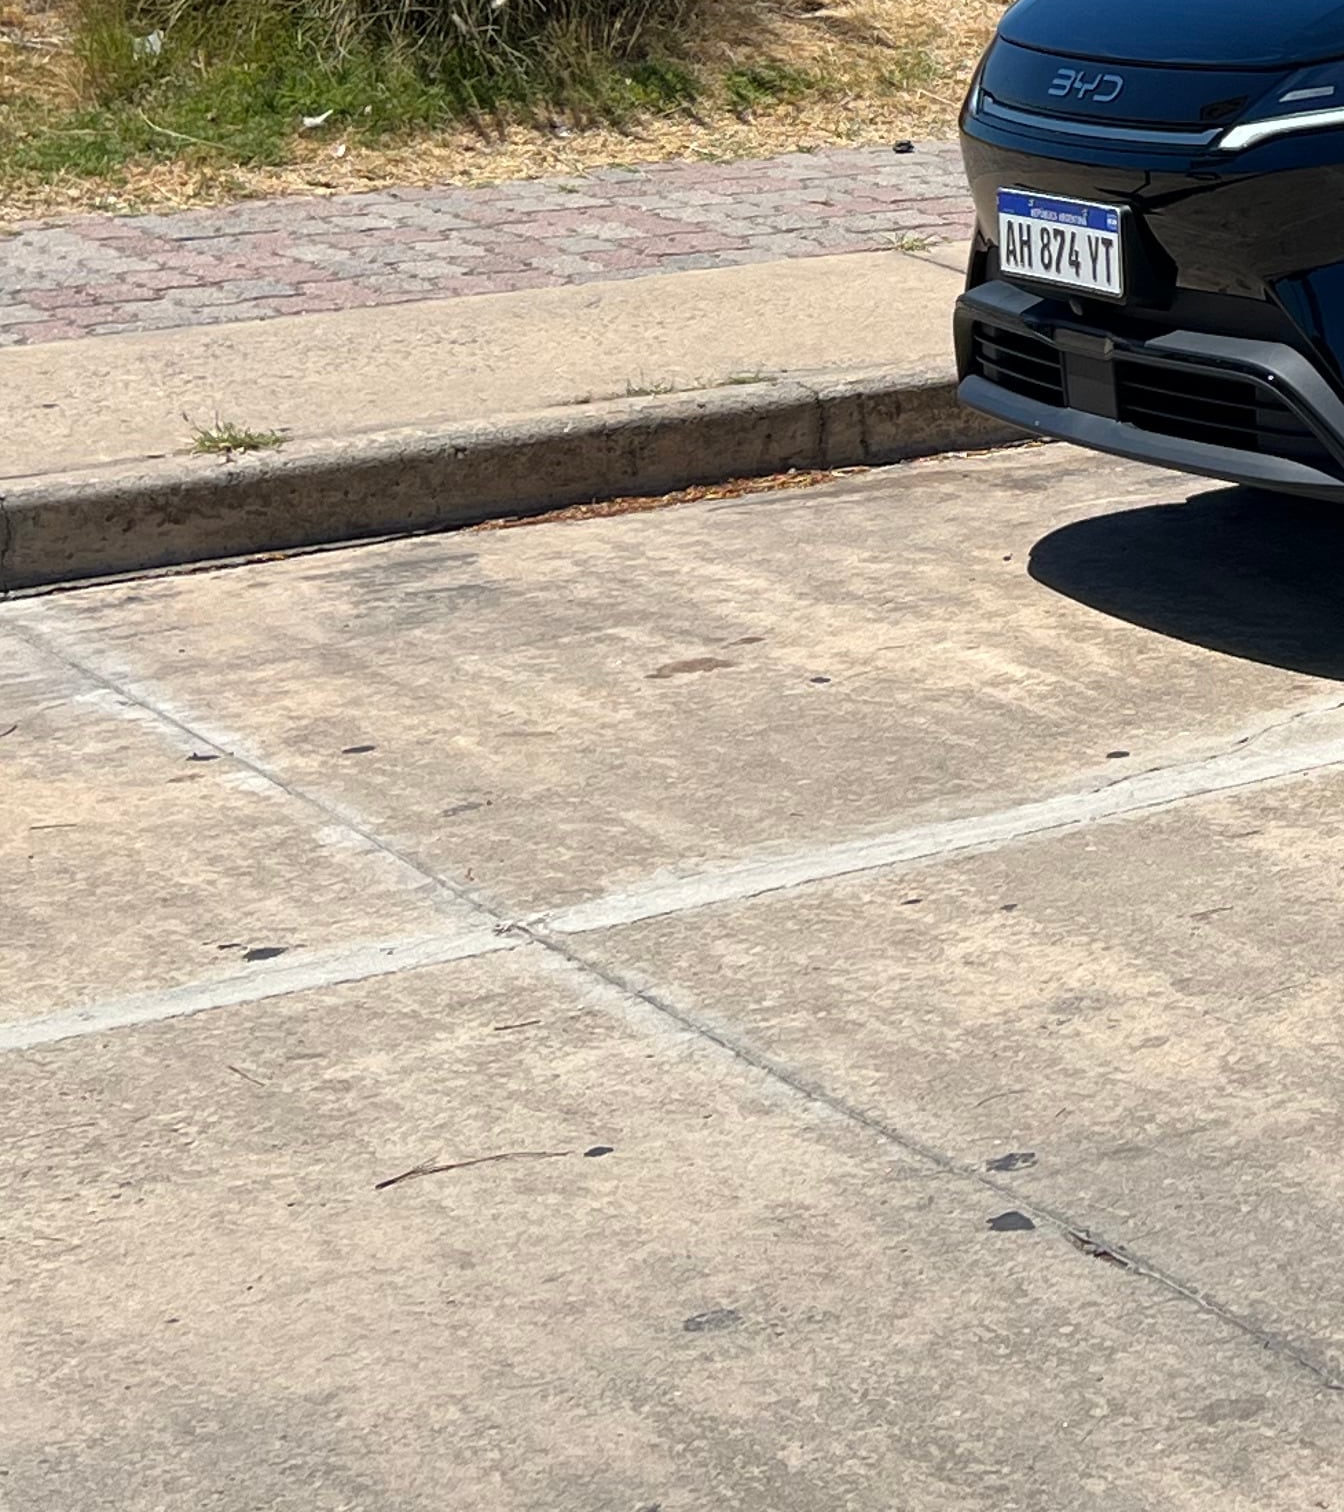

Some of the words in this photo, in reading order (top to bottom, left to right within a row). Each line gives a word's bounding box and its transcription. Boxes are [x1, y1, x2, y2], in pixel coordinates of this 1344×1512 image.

[1047, 68, 1124, 102] BYD
[1006, 219, 1033, 269] AH
[1040, 226, 1082, 278] 874
[1087, 234, 1114, 286] YT
